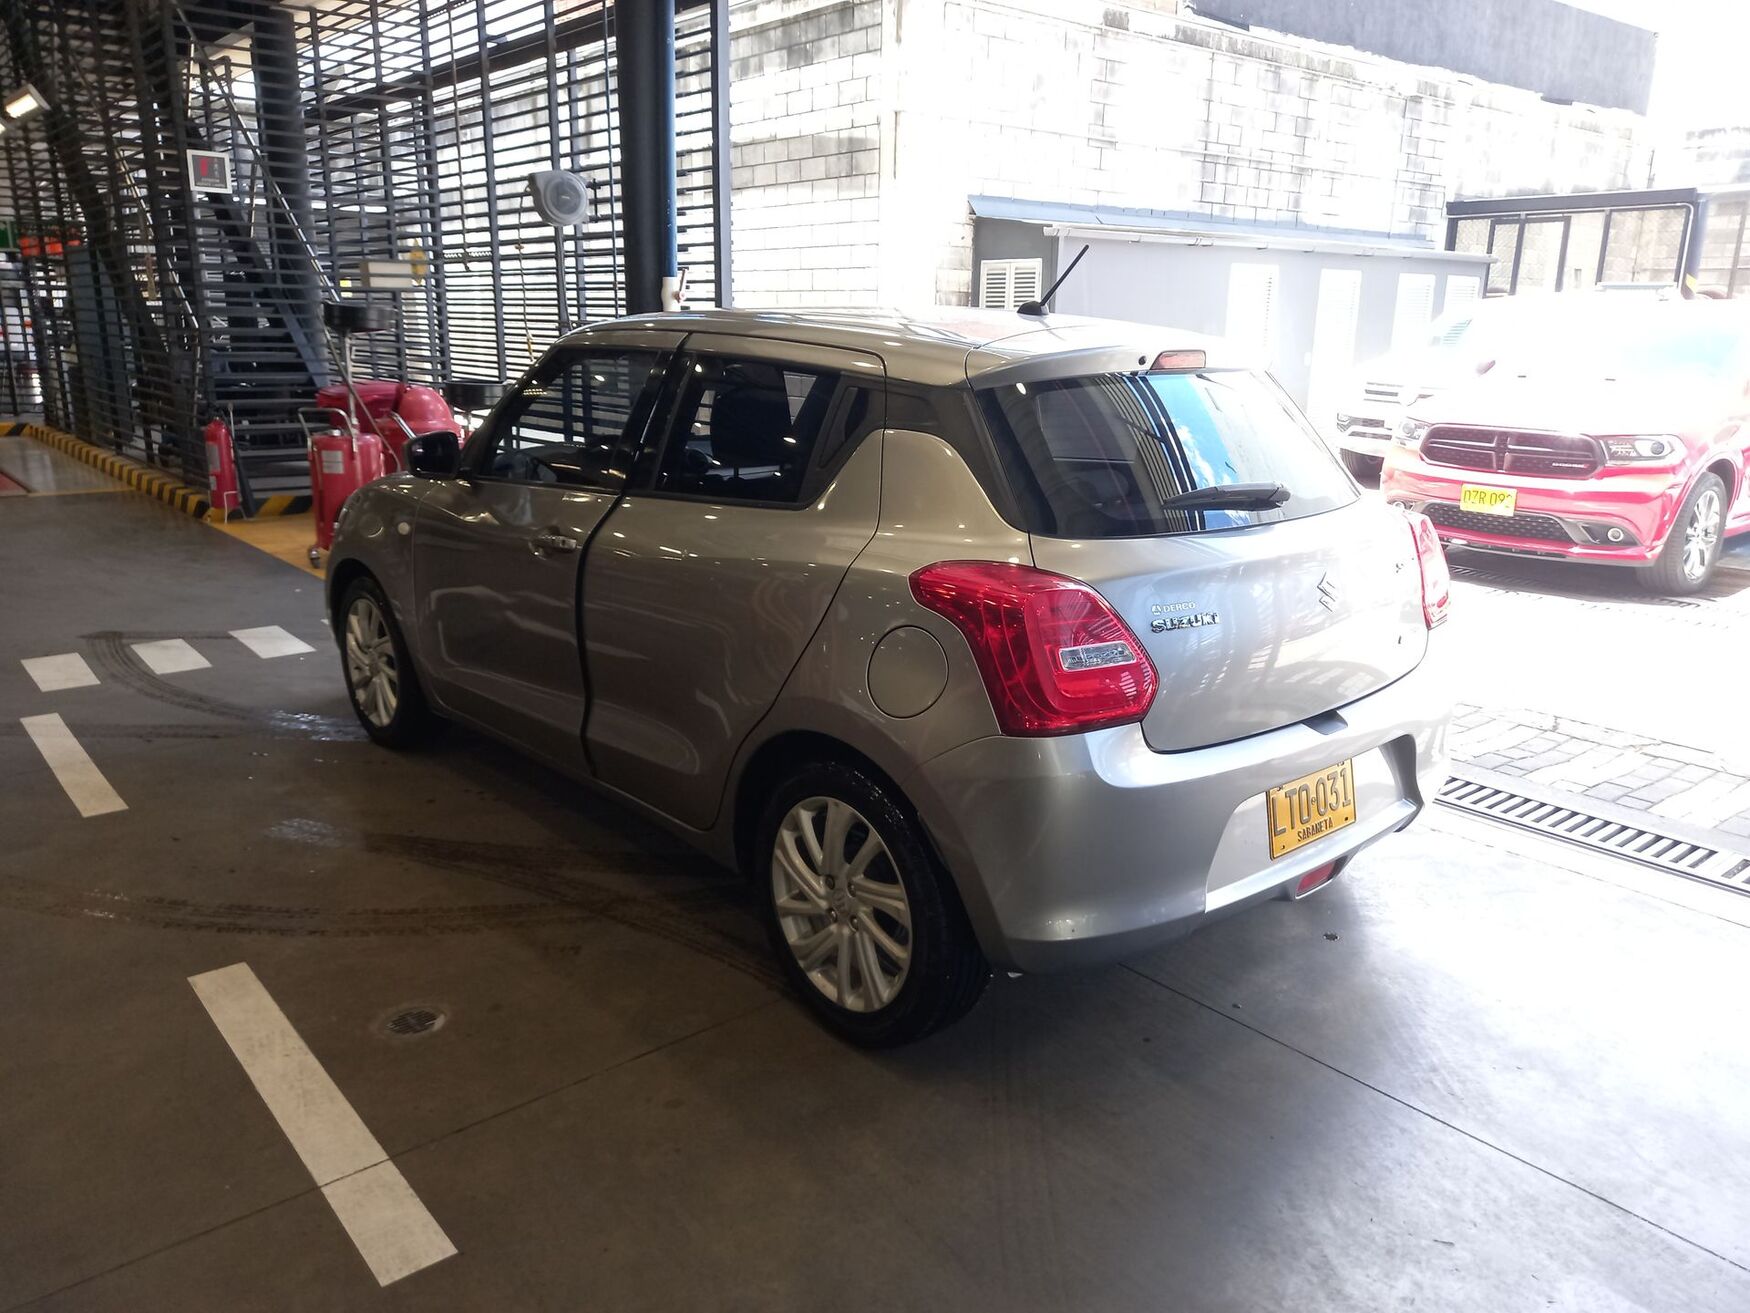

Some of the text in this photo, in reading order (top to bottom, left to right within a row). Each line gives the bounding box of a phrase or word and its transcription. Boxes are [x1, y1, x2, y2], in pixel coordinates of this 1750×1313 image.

[1163, 601, 1196, 613] DERCO
[1151, 612, 1221, 634] SUZUKI
[1297, 816, 1334, 842] SABANETA
